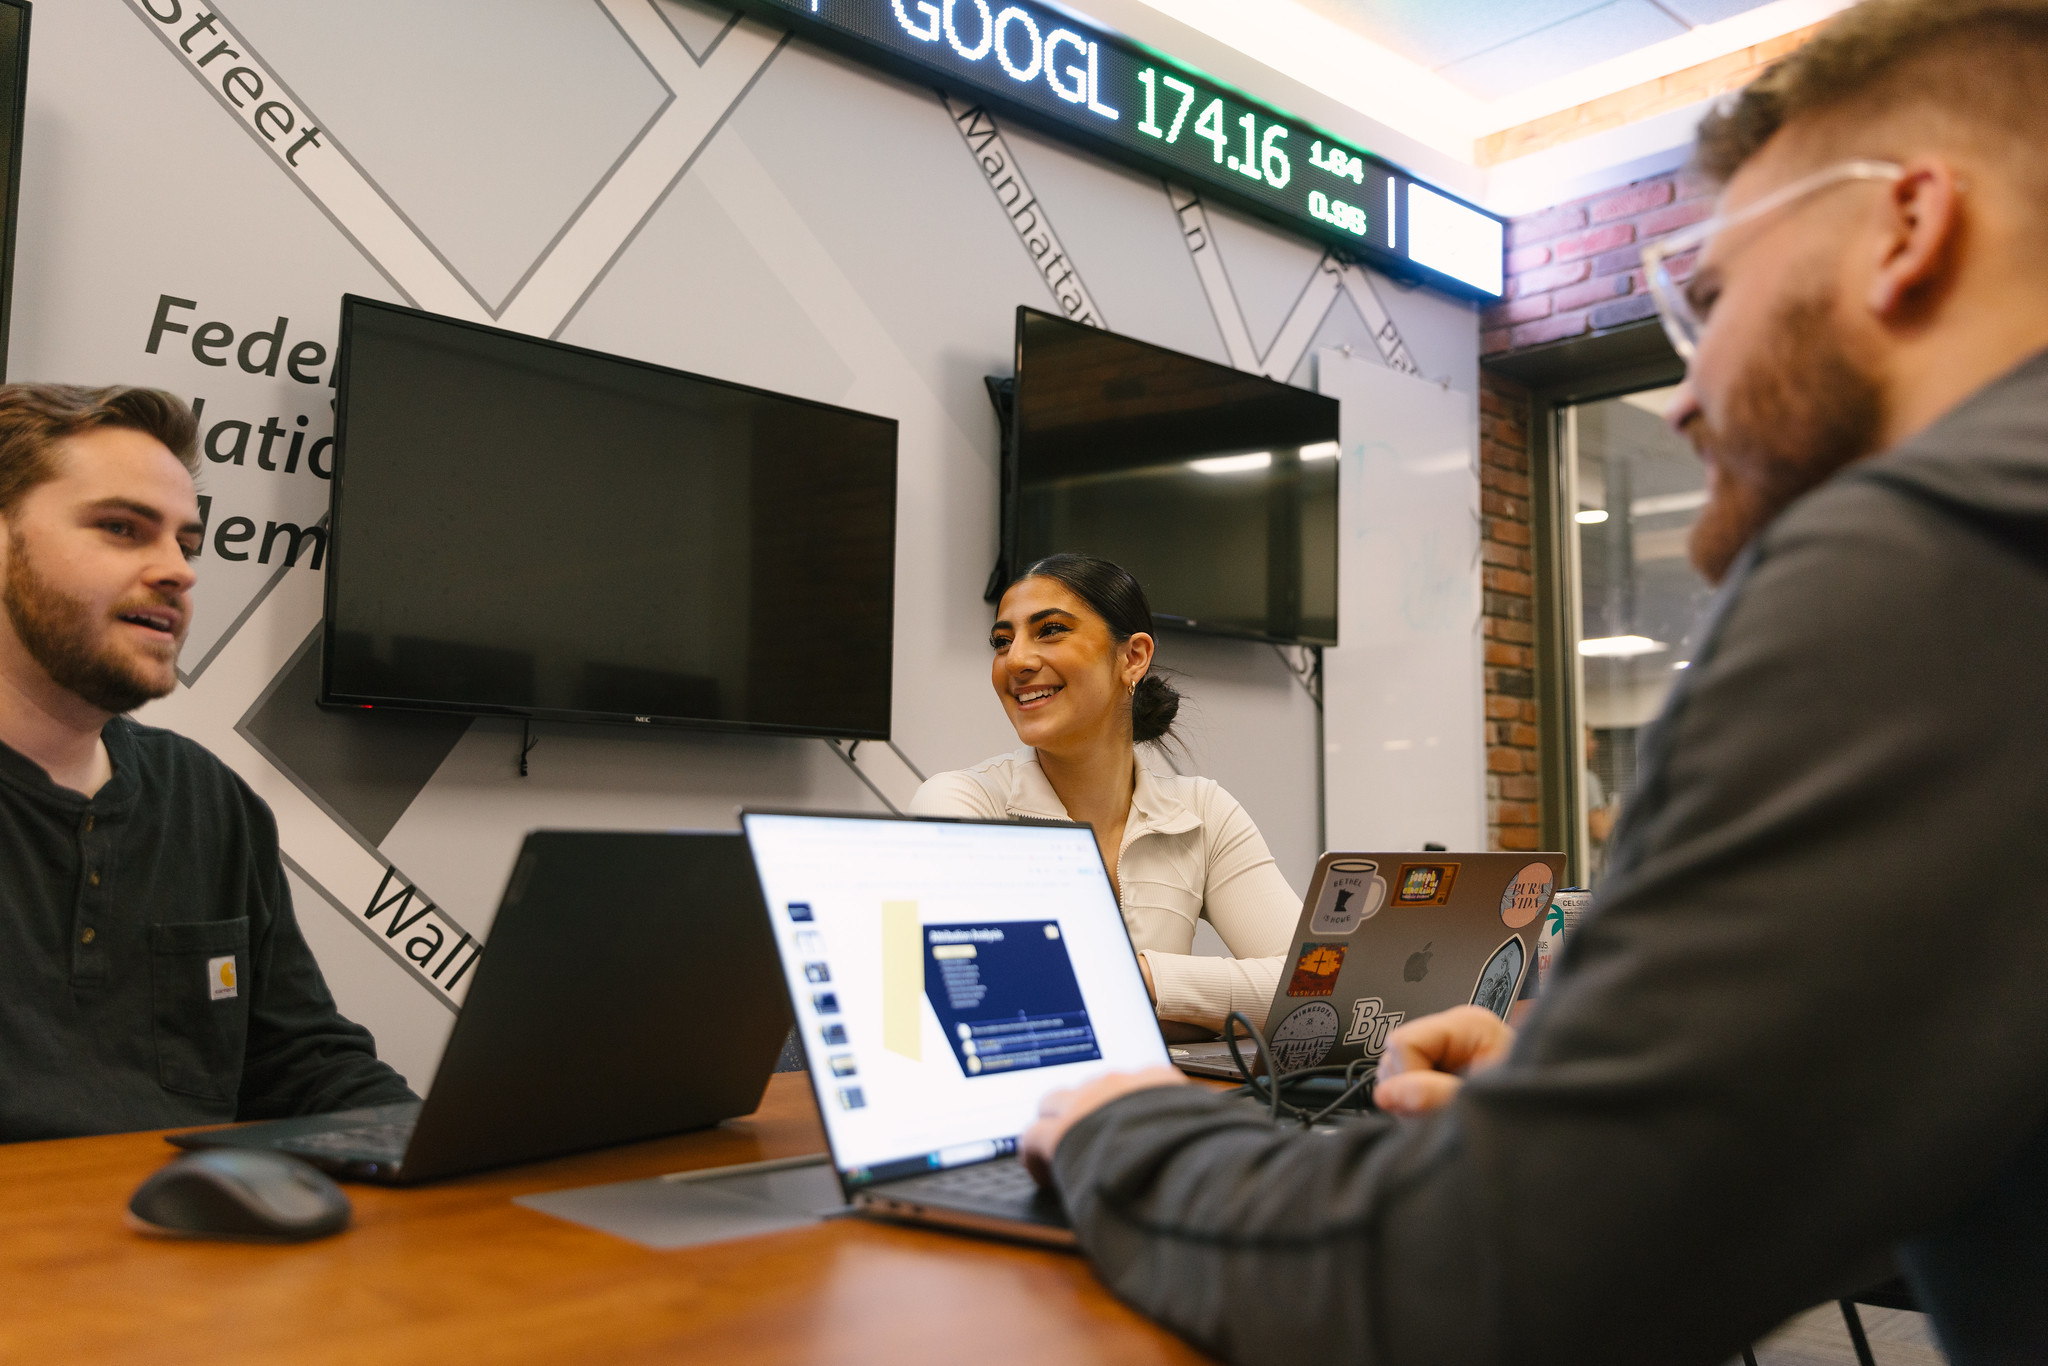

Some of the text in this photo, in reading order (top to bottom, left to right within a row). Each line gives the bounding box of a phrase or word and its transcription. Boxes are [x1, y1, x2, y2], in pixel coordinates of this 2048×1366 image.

[893, 0, 1291, 189] GOOGL 174.16
[1178, 200, 1206, 253] Ln
[1334, 878, 1362, 887] BETHEL
[1512, 883, 1545, 895] PURA
[1511, 897, 1539, 909] VIDA
[364, 865, 484, 991] Wall
[1293, 1006, 1332, 1020] MINNESOTA
[1344, 999, 1404, 1057] BU
